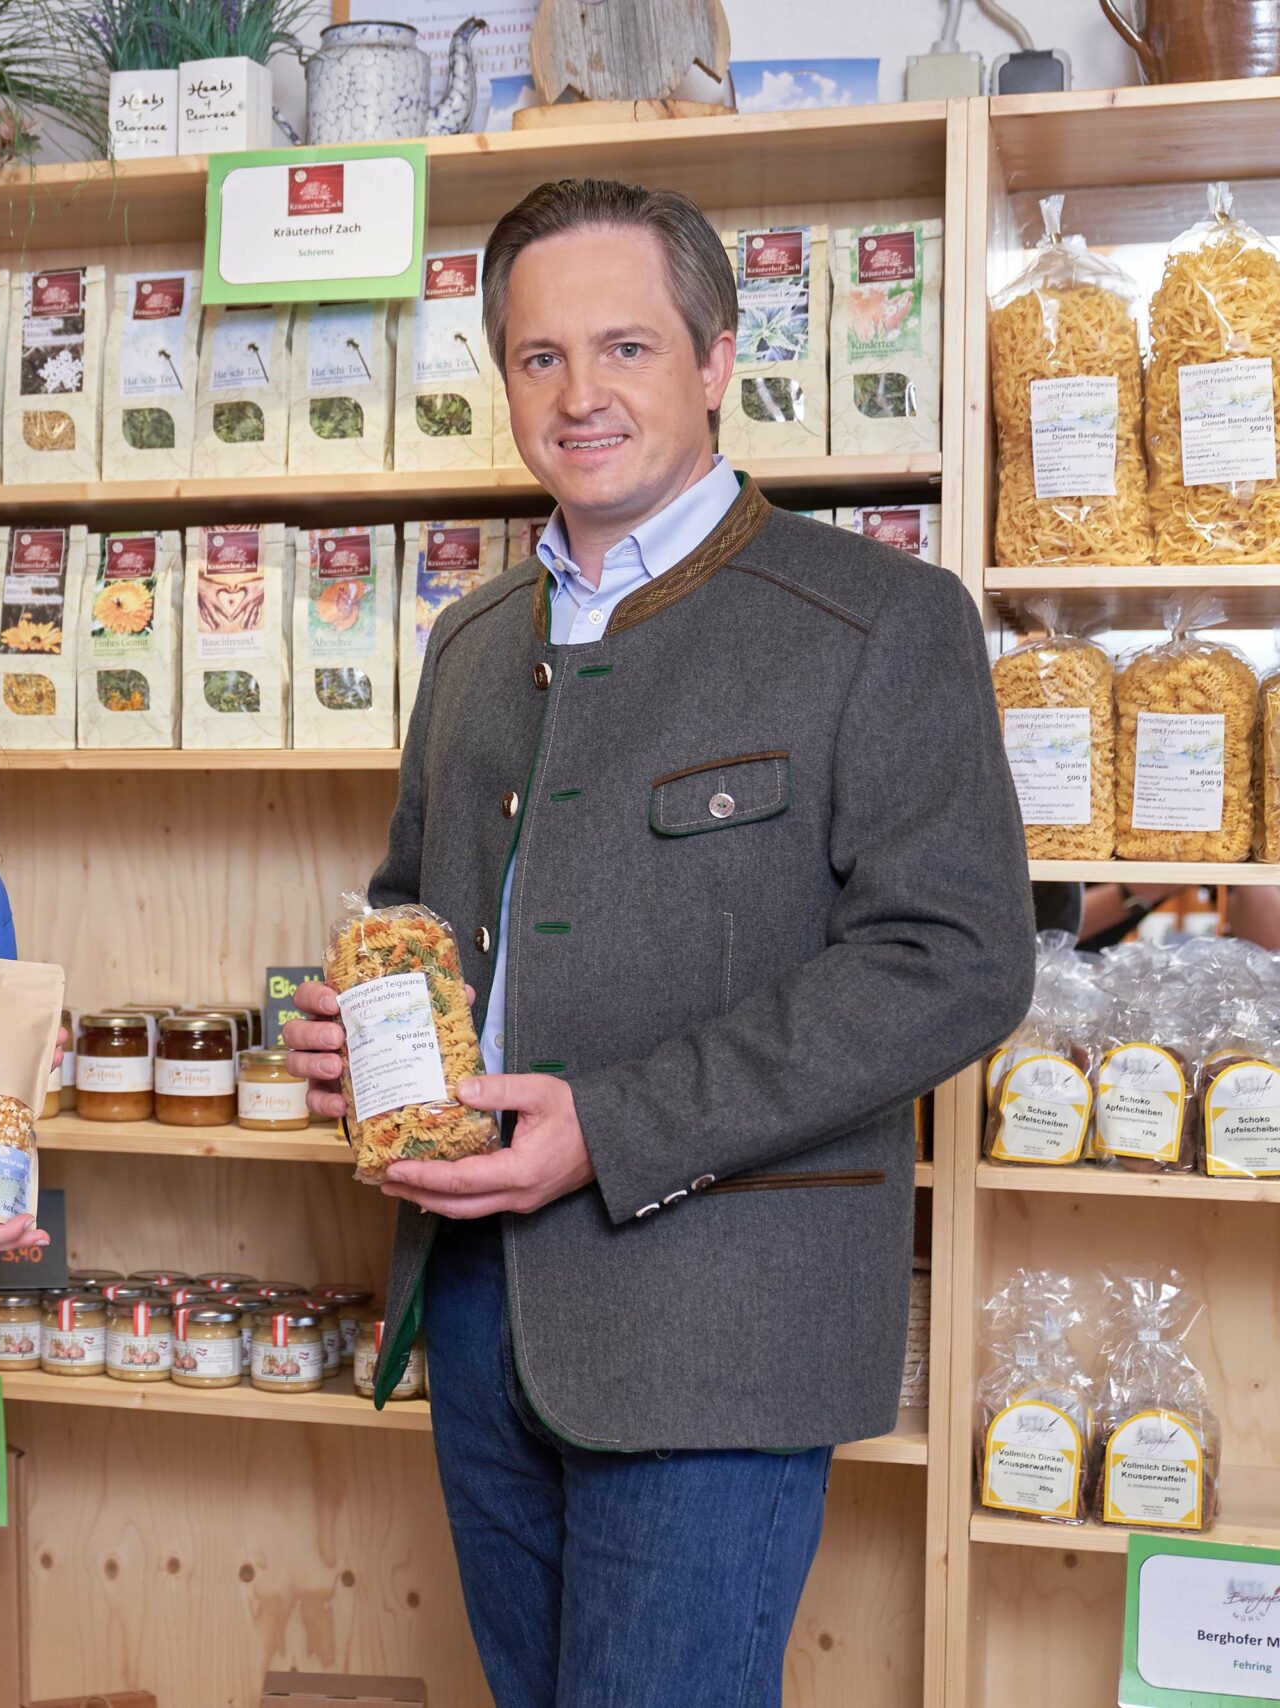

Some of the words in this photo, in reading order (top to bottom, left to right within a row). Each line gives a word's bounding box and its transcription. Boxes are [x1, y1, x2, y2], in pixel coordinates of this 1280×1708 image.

[273, 224, 334, 238] Kräuterhof
[336, 222, 362, 234] Zach
[298, 247, 335, 258] Schrems
[747, 264, 783, 274] Kräuterhof
[783, 262, 800, 271] Zach
[860, 267, 897, 279] Kräuterhof
[897, 265, 914, 275] Zach
[851, 339, 897, 350] Kindertee
[1228, 415, 1273, 424] Bandnudeln
[901, 541, 918, 550] Zach
[201, 636, 255, 647] Bauchfreund
[313, 636, 354, 647] Abendtee
[1055, 761, 1088, 769] Spiralen
[1066, 775, 1081, 783] 500
[338, 984, 385, 1007] erschlingtaler
[395, 1030, 431, 1042] Spiralen
[411, 1043, 427, 1052] 500
[1119, 1095, 1151, 1105] Schoko
[1027, 1105, 1058, 1117] Schoko
[1105, 1103, 1164, 1117] Apfelscheiben
[1012, 1112, 1069, 1129] Apfelscheiben
[1238, 1116, 1271, 1124] Schoko
[1141, 1129, 1157, 1138] 125g
[998, 1448, 1036, 1461] Vollmilch
[1037, 1452, 1064, 1463] Dinkel
[998, 1458, 1063, 1474] Knusperwaffeln
[1121, 1461, 1160, 1472] Vollmilch
[1161, 1463, 1189, 1474] Dinkel
[1121, 1471, 1187, 1484] Knusperwaffeln
[1197, 1629, 1263, 1646] Berghofer
[1233, 1659, 1272, 1674] Fehring
